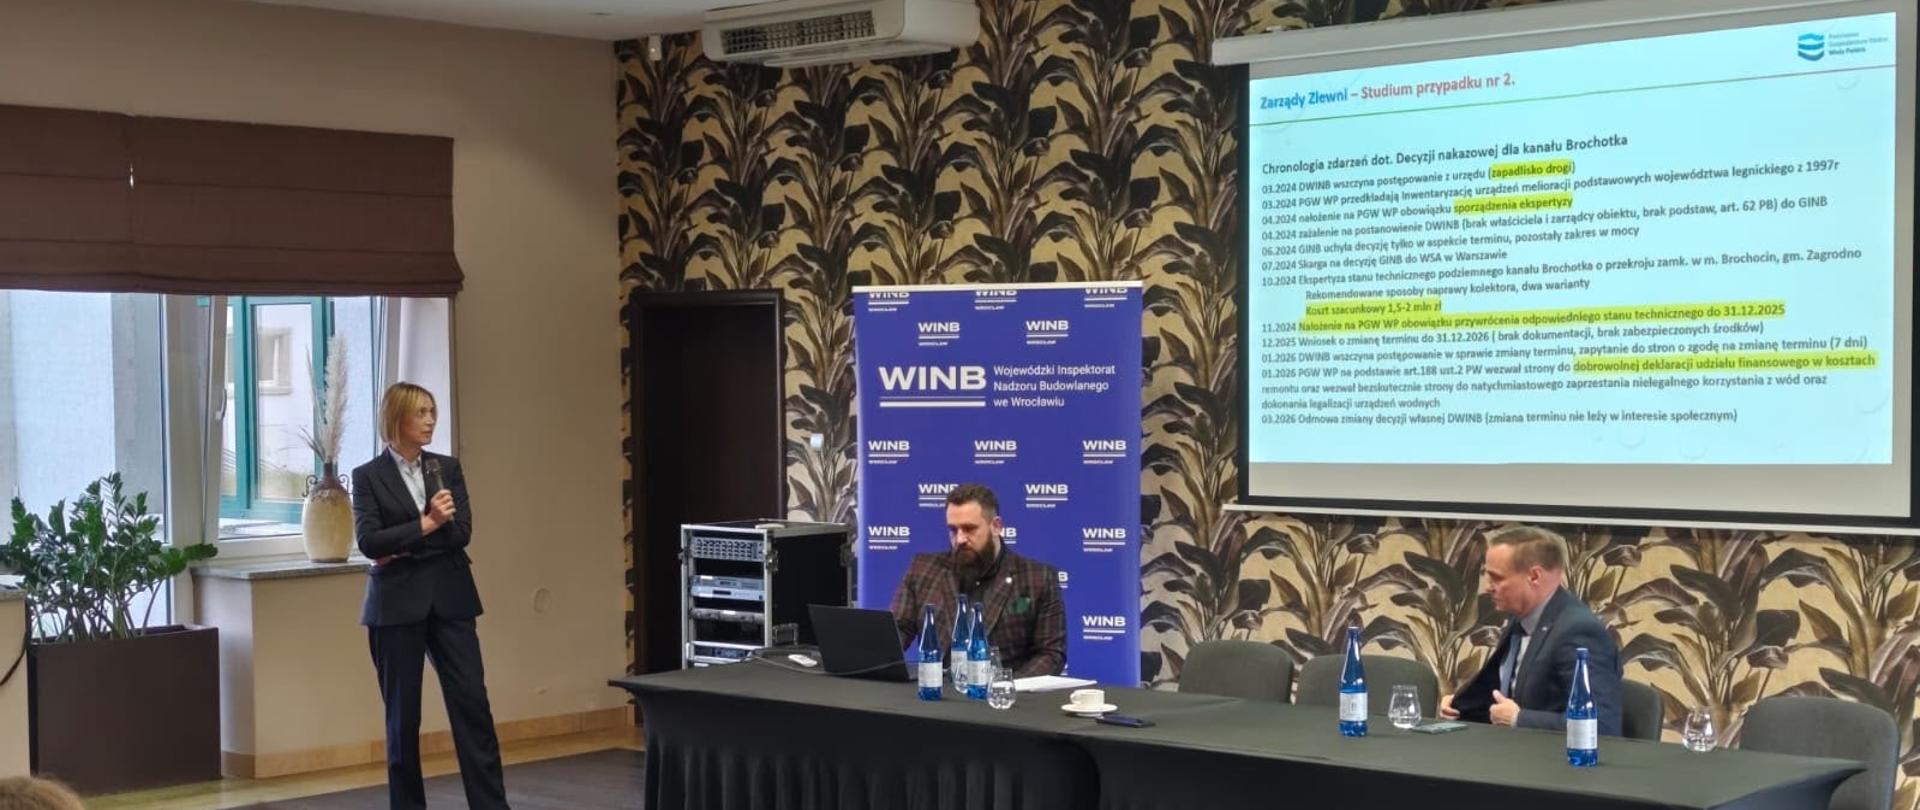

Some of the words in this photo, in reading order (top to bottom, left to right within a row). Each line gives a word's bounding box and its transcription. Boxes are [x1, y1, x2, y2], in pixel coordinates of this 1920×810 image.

[1260, 94, 1306, 110] Zarządy
[1360, 84, 1413, 100] Studium
[1415, 77, 1482, 97] przypadku
[1485, 77, 1500, 87] nr
[1503, 73, 1514, 85] 2.
[1262, 159, 1324, 174] Chronologia
[1327, 155, 1368, 169] zdarzeń
[1370, 154, 1392, 166] dot.
[1395, 150, 1435, 165] Decyzji
[1437, 145, 1498, 160] nakazowej
[1501, 143, 1519, 155] dla
[1565, 134, 1627, 150] Brochotka
[1262, 182, 1296, 194] 03.2024
[1298, 180, 1330, 191] DWINB
[1332, 179, 1375, 189] wszczyna
[1376, 172, 1442, 188] postępowanie
[1487, 164, 1543, 180] (zapadlisko
[1544, 161, 1575, 174] drogi)
[1262, 198, 1296, 209] 03.2024
[1298, 196, 1320, 207] PGW
[1322, 195, 1338, 205] WP
[1474, 182, 1518, 196] urządzeń
[1521, 179, 1570, 192] melioracji
[1573, 173, 1651, 190] podstawowych
[1654, 169, 1729, 183] województwa
[1731, 164, 1794, 178] legnickiego
[1806, 160, 1838, 171] 1997r
[1356, 209, 1380, 220] PGW
[1381, 208, 1398, 218] WP
[1518, 198, 1572, 210] ekspertyzy
[1424, 219, 1459, 230] DWINB
[1462, 217, 1487, 230] (brak
[1550, 211, 1594, 224] zarządcy
[1596, 209, 1640, 220] obiektu,
[1642, 206, 1666, 217] brak
[1668, 205, 1716, 217] podstaw,
[1720, 203, 1739, 212] art.
[1742, 201, 1756, 211] 62
[1758, 199, 1778, 211] PB)
[1780, 198, 1795, 208] do
[1798, 196, 1827, 207] GINB
[1390, 239, 1414, 251] tylko
[1426, 236, 1467, 249] aspekcie
[1470, 234, 1512, 245] terminu,
[1514, 230, 1562, 244] pozostały
[1564, 229, 1596, 239] zakres
[1610, 228, 1639, 237] mocy
[1375, 270, 1436, 281] technicznego
[1438, 267, 1503, 280] podziemnego
[1541, 262, 1593, 274] Brochotka
[1604, 258, 1655, 272] przekroju
[1656, 257, 1688, 268] zamk.
[1720, 252, 1779, 264] Brochocin,
[1782, 253, 1804, 263] gm.
[1806, 248, 1861, 261] Zagrodno
[1378, 255, 1402, 265] GINB
[1404, 254, 1417, 264] do
[1419, 253, 1442, 263] WSA
[1454, 249, 1507, 261] Warszawie
[1469, 283, 1518, 293] kolektora,
[1521, 281, 1542, 291] dwa
[1544, 279, 1590, 290] warianty
[1357, 320, 1381, 329] PGW
[1381, 319, 1399, 329] WP
[1454, 314, 1519, 328] przywrócenia
[1521, 312, 1601, 325] odpowiedniego
[1602, 312, 1632, 321] stanu
[1634, 308, 1704, 319] technicznego
[1706, 306, 1720, 316] do
[1723, 304, 1785, 316] 31.12.2025
[918, 322, 960, 332] WINB
[1026, 320, 1069, 331] WINB
[1381, 334, 1419, 344] terminu
[1420, 333, 1434, 343] do
[1436, 332, 1489, 343] 31.12.2026
[1497, 331, 1520, 341] brak
[1521, 328, 1594, 340] dokumentacji,
[1596, 327, 1620, 338] brak
[1622, 324, 1710, 338] zabezpieczonych
[1494, 347, 1531, 358] zmiany
[1532, 346, 1576, 357] terminu,
[1578, 344, 1628, 357] zapytanie
[1631, 344, 1645, 354] do
[1647, 344, 1675, 353] stron
[1687, 341, 1719, 354] zgodę
[1721, 343, 1736, 351] na
[1781, 338, 1827, 349] terminu
[1829, 338, 1841, 350] (7
[1844, 337, 1867, 349] dni)
[994, 365, 1054, 377] Wojewódzki
[1058, 365, 1115, 376] Inspektorat
[1523, 364, 1555, 374] strony
[1556, 362, 1570, 372] do
[1572, 361, 1639, 373] dobrowolnej
[1641, 359, 1693, 371] deklaracji
[1737, 358, 1810, 369] finansowego
[1824, 355, 1875, 366] kosztach
[879, 366, 987, 390] WINB
[1470, 379, 1564, 392] natychmiastowego
[1565, 378, 1630, 390] zaprzestania
[1632, 376, 1699, 388] nielegalnego
[1702, 375, 1764, 387] korzystania
[1774, 374, 1800, 384] wód
[1802, 376, 1827, 384] oraz
[994, 381, 1036, 391] Nadzoru
[1040, 381, 1109, 392] Budowlanego
[1011, 397, 1064, 406] Wrocławiu
[1446, 413, 1482, 423] DWINB
[1484, 413, 1524, 424] (zmiana
[1525, 412, 1566, 422] terminu
[1568, 412, 1584, 422] nie
[1620, 411, 1667, 421] interesie
[868, 441, 910, 451] WINB
[974, 440, 1017, 451] WINB
[1083, 440, 1126, 450] WINB
[1025, 484, 1068, 494] WINB
[868, 526, 910, 536] WINB
[1083, 528, 1126, 539] WINB
[1083, 616, 1126, 627] WINB
